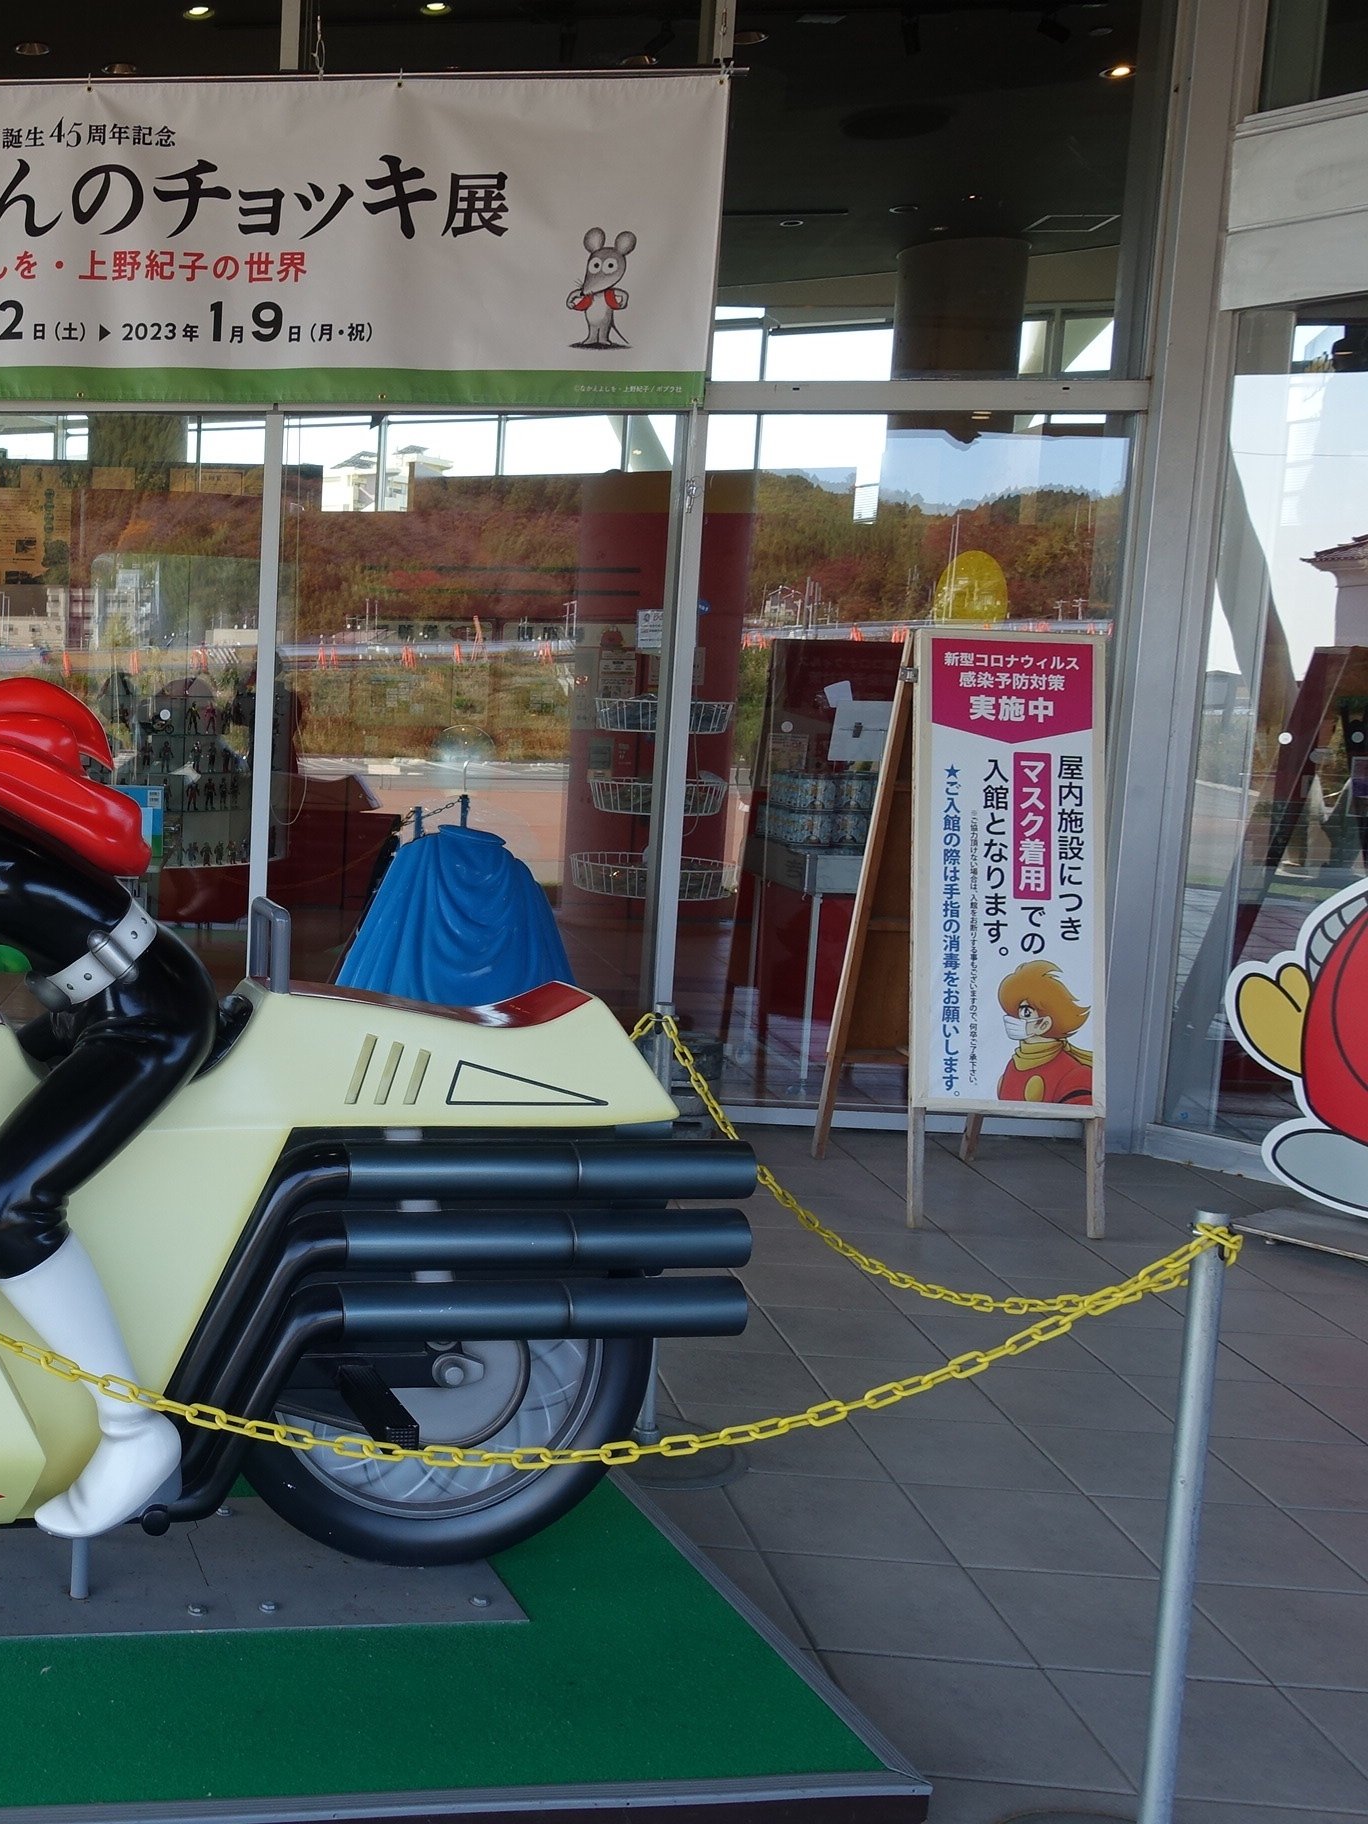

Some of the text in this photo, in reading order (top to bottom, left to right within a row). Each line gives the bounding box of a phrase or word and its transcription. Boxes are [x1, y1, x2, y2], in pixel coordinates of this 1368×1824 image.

[2, 116, 176, 150] 誕生45周年記念
[944, 652, 1080, 671] 新型コロナウィルス
[959, 672, 1066, 691] 感染予防対策
[969, 695, 1054, 723] 実施中
[982, 758, 1009, 957] 入館となります。
[1057, 755, 1085, 942] 屋内施設につき
